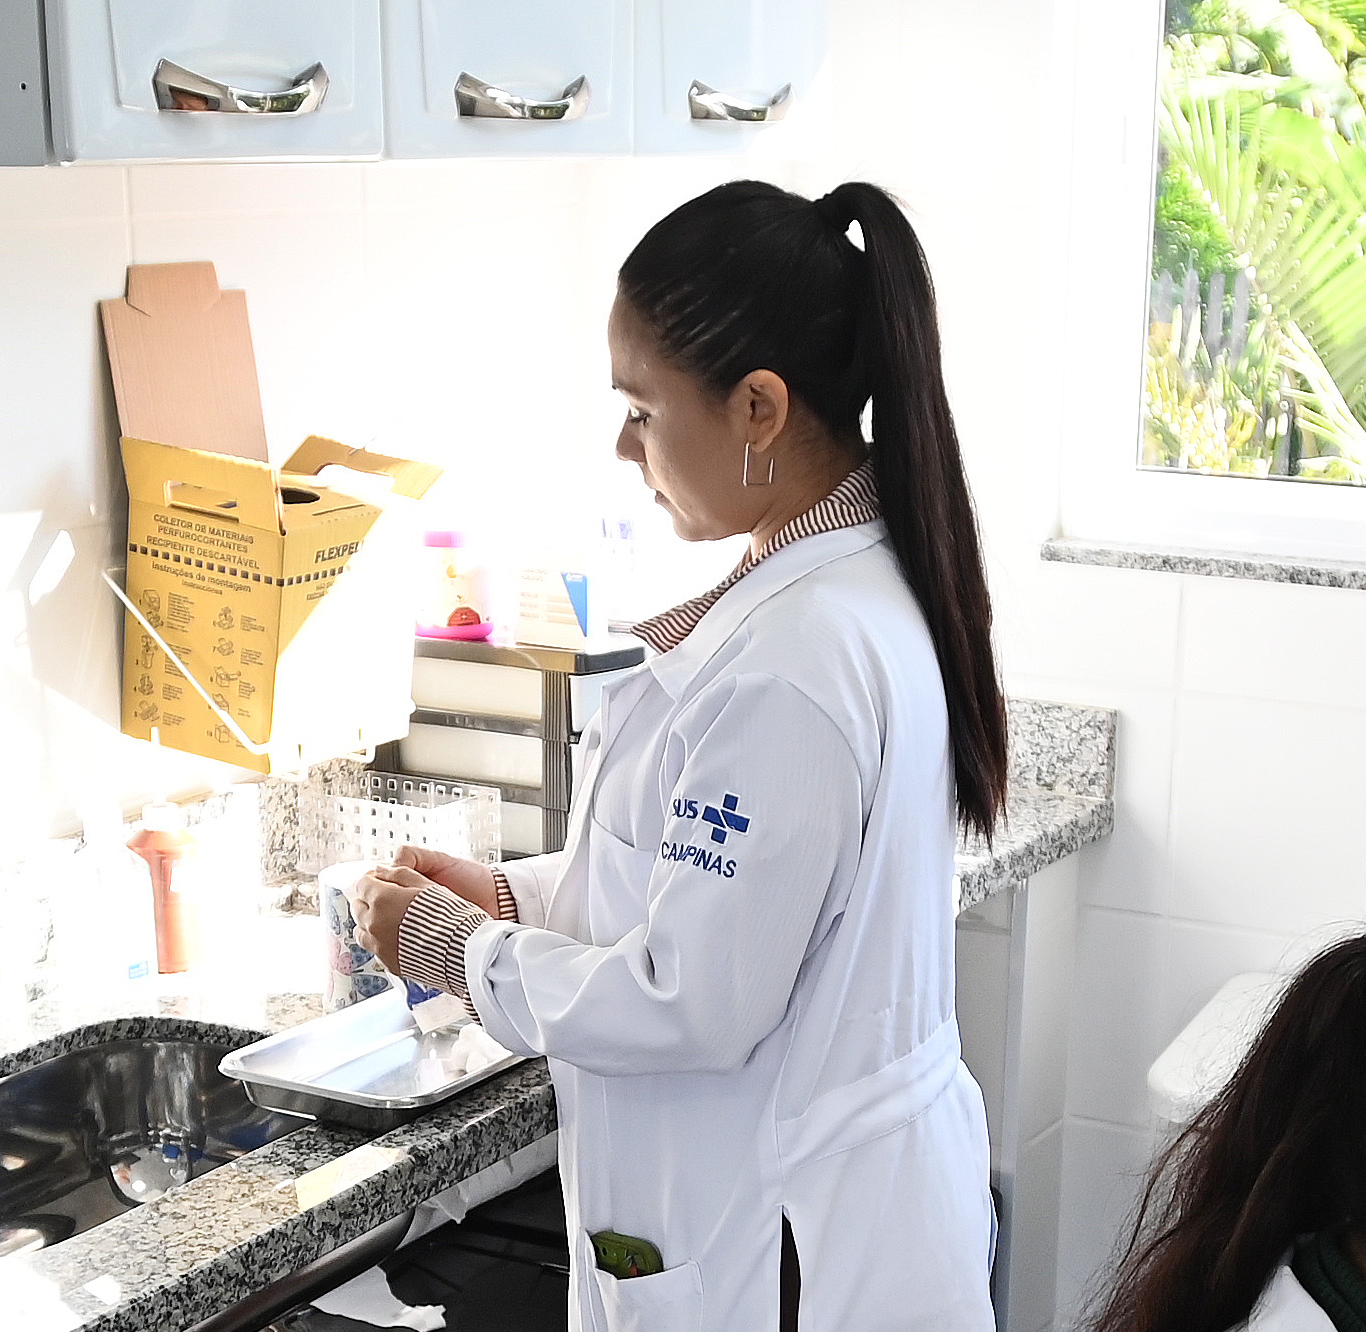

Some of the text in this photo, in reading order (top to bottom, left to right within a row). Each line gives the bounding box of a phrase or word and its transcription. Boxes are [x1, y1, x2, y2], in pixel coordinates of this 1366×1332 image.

[153, 514, 254, 545] COLETOR DE MATERIAIS
[157, 525, 248, 553] PERFUROCORTANTES
[147, 535, 260, 569] RECIPIENTE DESCARTÁVEL
